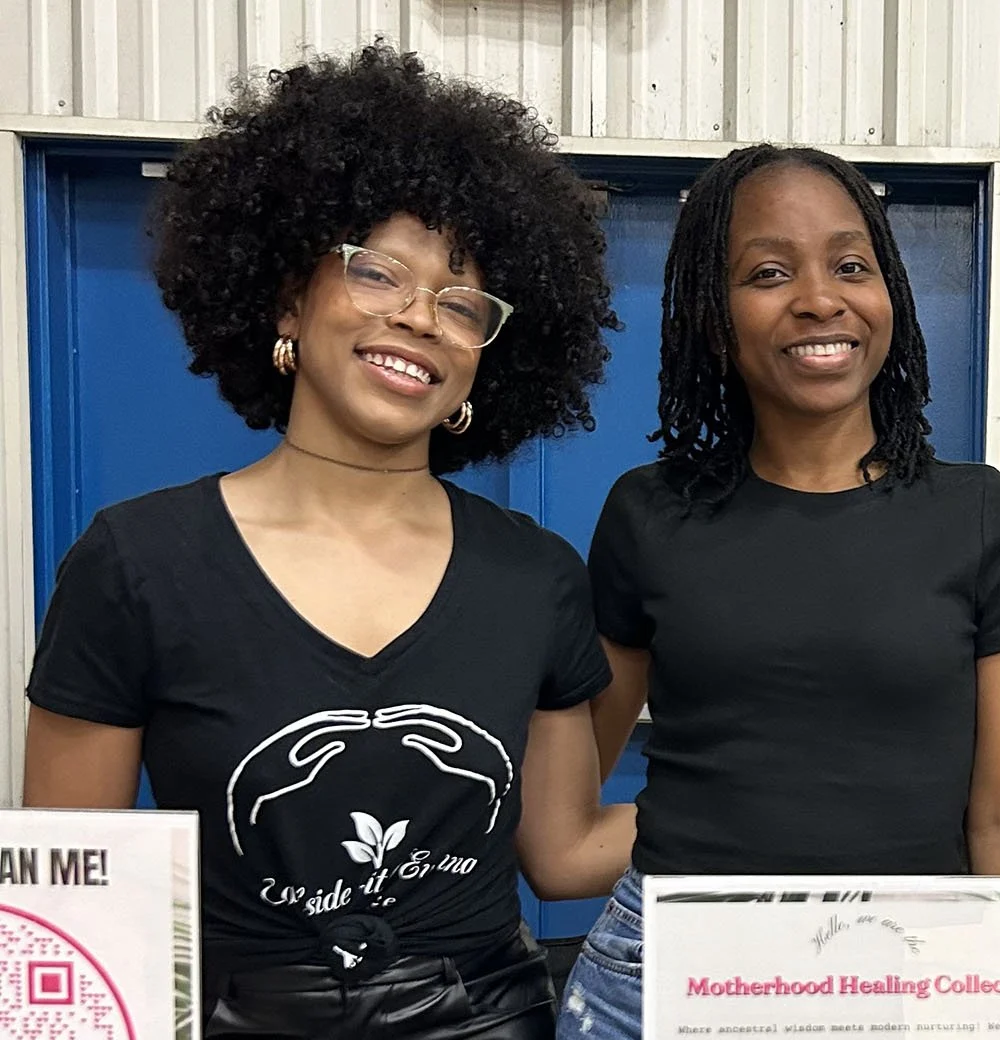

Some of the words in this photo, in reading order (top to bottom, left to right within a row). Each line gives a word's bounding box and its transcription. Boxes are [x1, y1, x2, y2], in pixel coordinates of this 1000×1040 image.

[50, 848, 109, 886] ME!
[685, 976, 835, 996] Motherhood
[838, 975, 932, 998] Healing
[677, 1025, 713, 1035] Where
[717, 1025, 778, 1034] ancestral
[783, 1024, 826, 1034] wisdom
[829, 1024, 865, 1032] meets
[869, 1023, 911, 1033] modern
[916, 1023, 980, 1032] nurturing!
